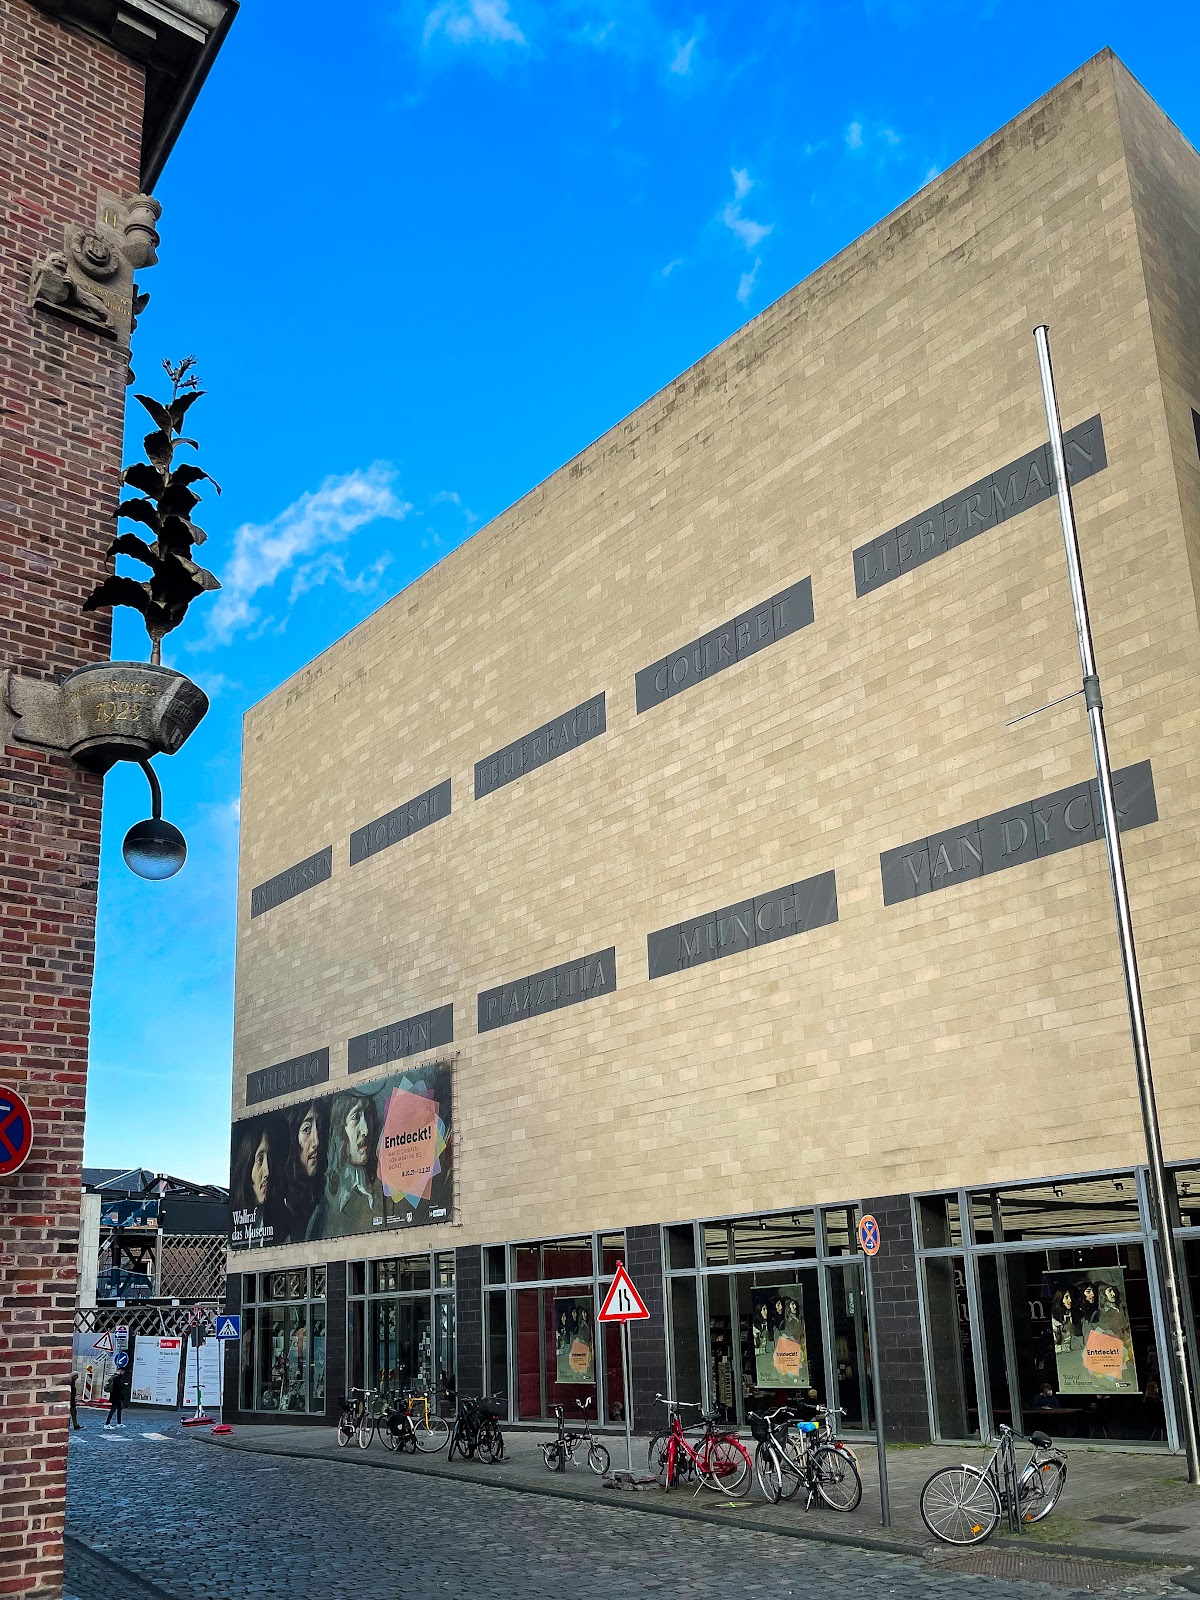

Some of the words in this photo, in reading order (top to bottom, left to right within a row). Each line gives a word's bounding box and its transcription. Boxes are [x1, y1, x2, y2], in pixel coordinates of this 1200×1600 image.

[654, 596, 791, 692] COURBET
[478, 701, 602, 791] FEUERBACH
[359, 791, 440, 855] MORISOT
[271, 854, 332, 903] HEMESSEN
[901, 828, 986, 884] VAN
[677, 891, 802, 962] MUNCH
[486, 959, 608, 1022] PIAZZETTA
[367, 1018, 431, 1060] BRUYN
[255, 1057, 319, 1097] MURILLO
[385, 1126, 432, 1149] Entdeckt!
[231, 1225, 243, 1241] das
[244, 1224, 274, 1240] Museum
[232, 1207, 258, 1226] Wallraf
[1087, 1348, 1120, 1356] Entdeckt!
